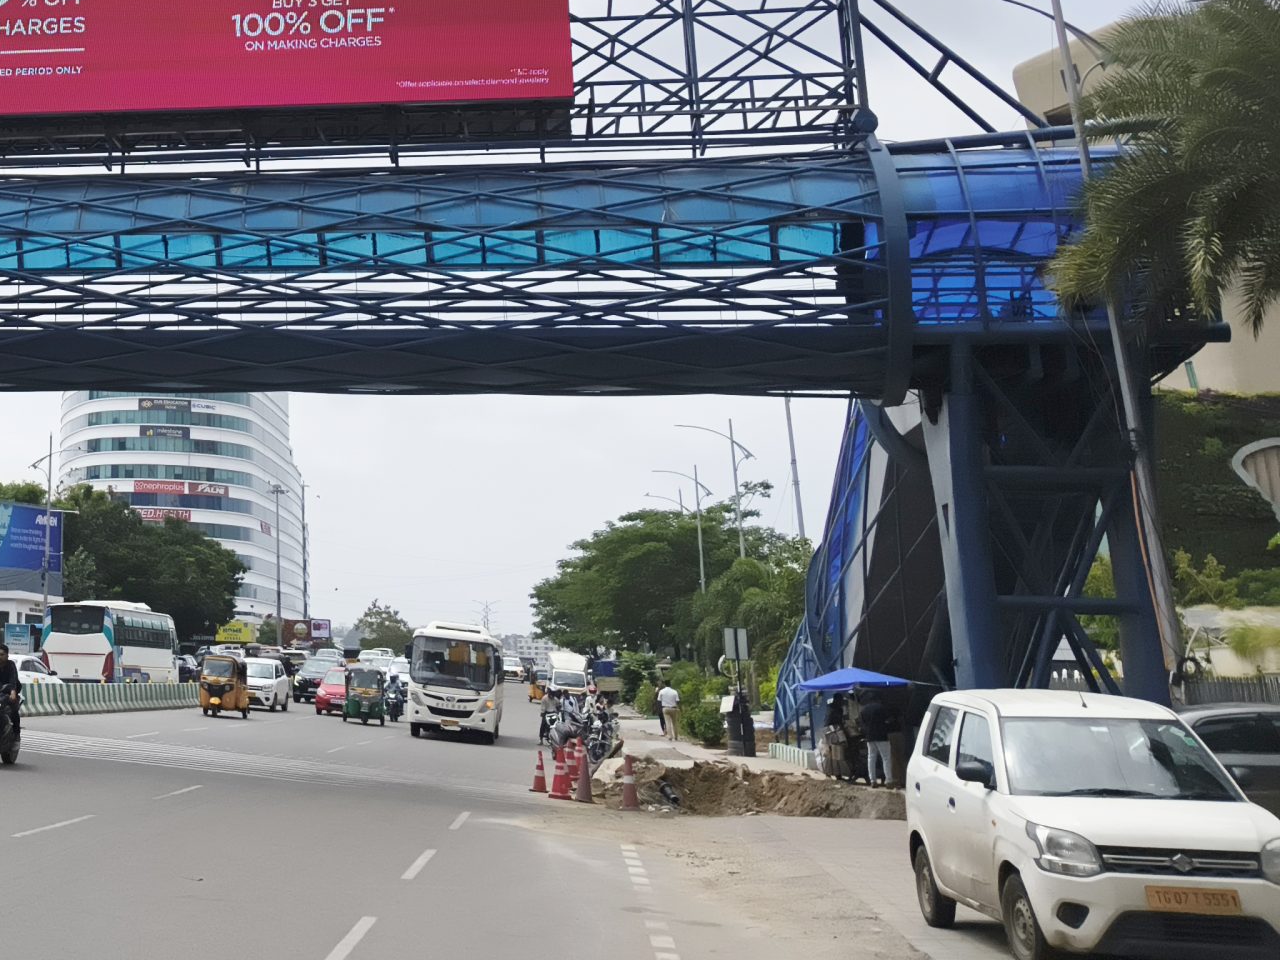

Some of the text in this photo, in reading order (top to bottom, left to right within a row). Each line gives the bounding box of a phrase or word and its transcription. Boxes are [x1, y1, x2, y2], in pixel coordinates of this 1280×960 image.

[231, 11, 311, 37] 100%
[245, 36, 382, 51] ON MAKING CHARGES
[15, 66, 53, 76] PERIOD
[56, 65, 83, 75] ONLY
[143, 482, 185, 491] nephroplus
